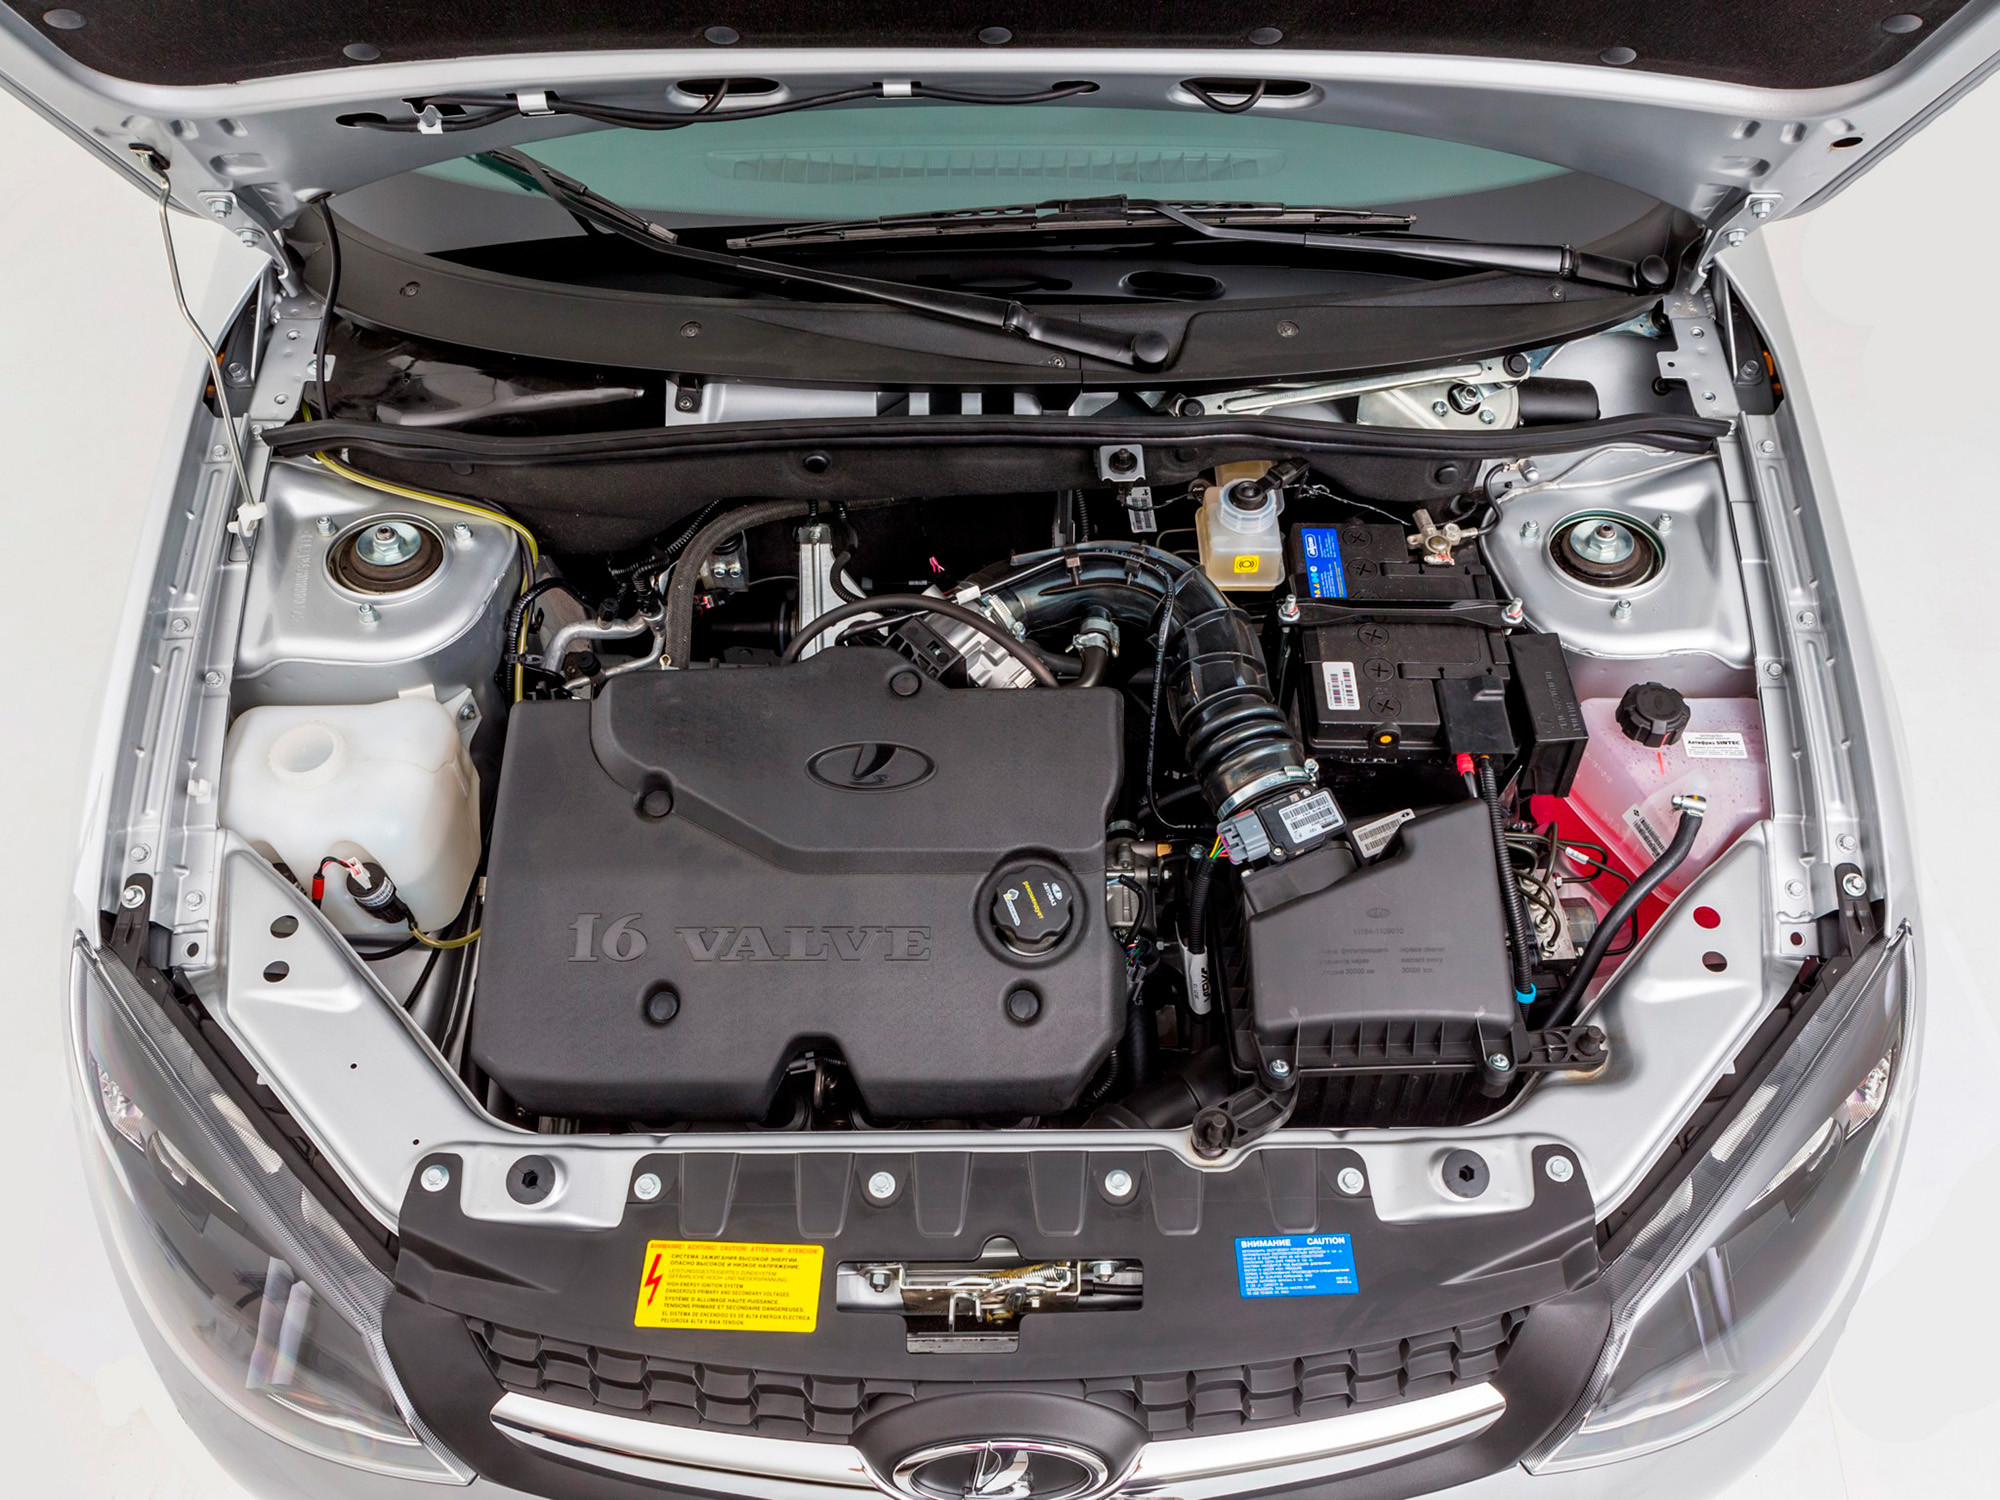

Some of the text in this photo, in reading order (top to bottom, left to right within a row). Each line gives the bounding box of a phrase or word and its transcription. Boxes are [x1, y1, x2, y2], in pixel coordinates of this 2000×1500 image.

[568, 912, 932, 962] 16 VALVE
[1241, 1239, 1291, 1248] ВНИМАНИЕ
[1307, 1237, 1345, 1245] CAUTION
